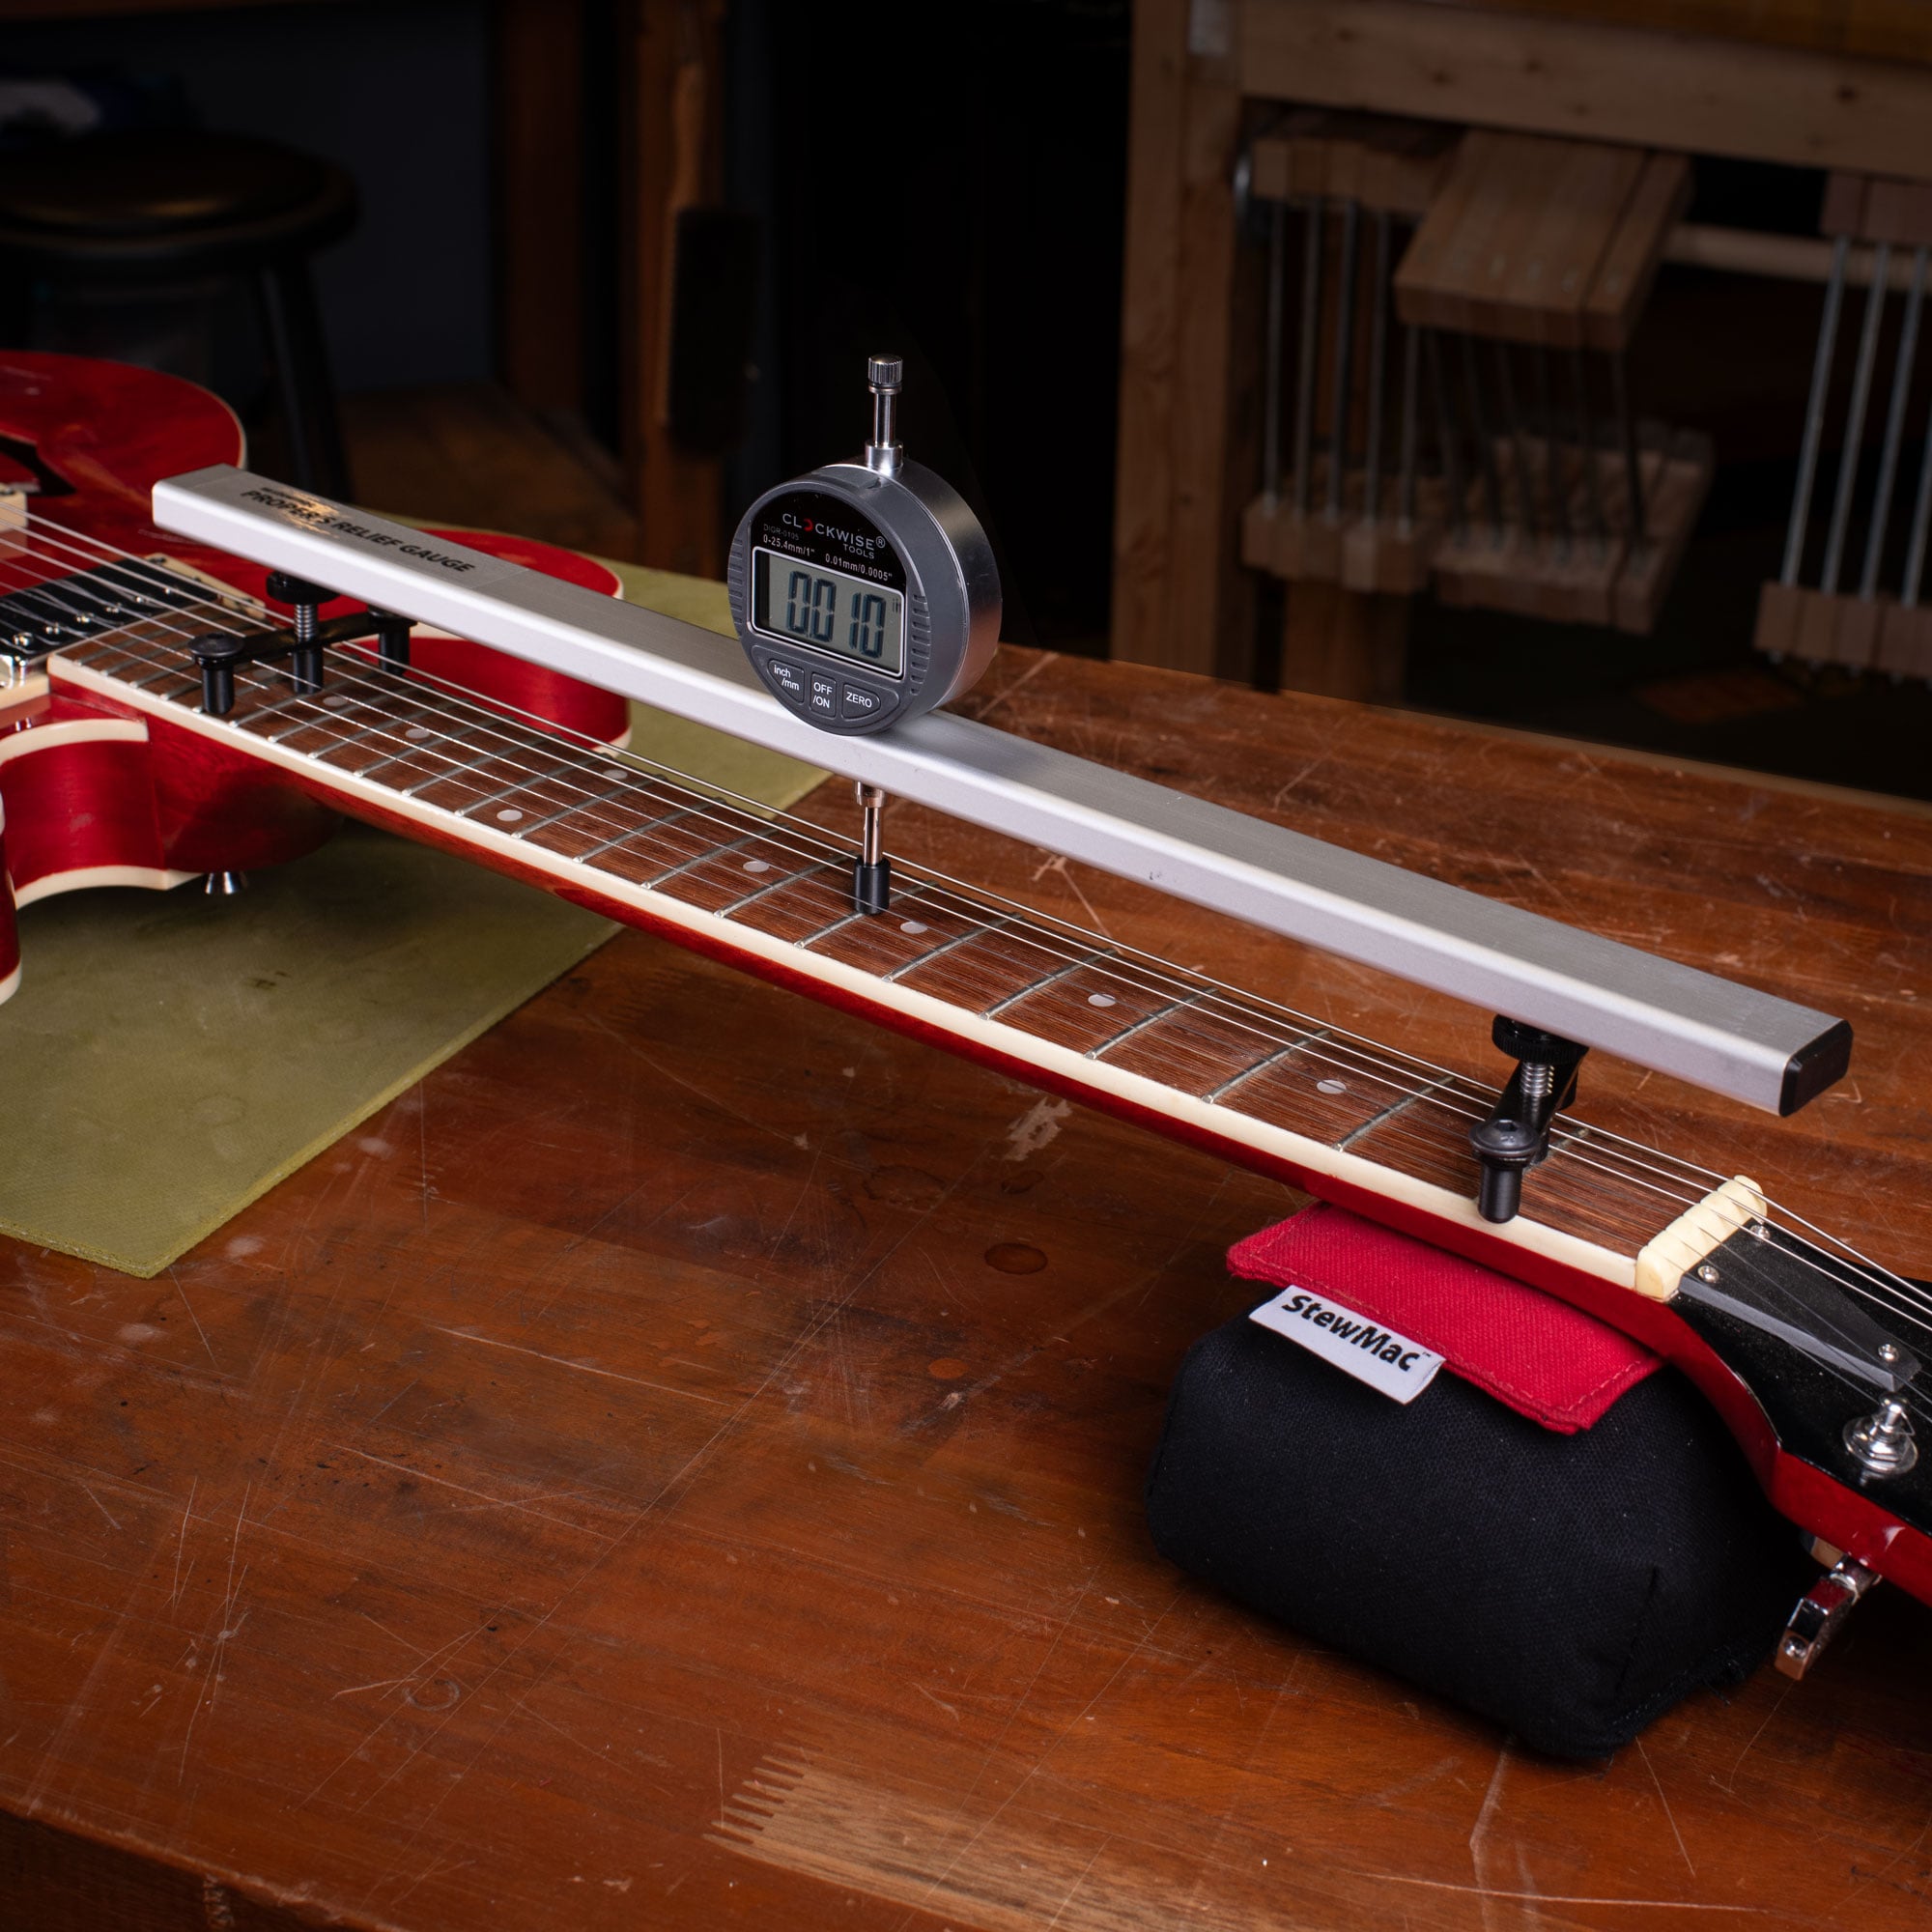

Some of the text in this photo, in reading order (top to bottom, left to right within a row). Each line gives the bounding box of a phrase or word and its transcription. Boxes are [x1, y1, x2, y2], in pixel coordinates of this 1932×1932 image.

[331, 522, 403, 546] RELIEF
[399, 545, 475, 572] GAUGE
[843, 543, 875, 559] TOOLS
[774, 664, 791, 678] inch
[781, 677, 800, 691] /mm
[813, 682, 833, 695] OFF
[812, 695, 830, 708] /ON
[846, 691, 873, 708] ZERO
